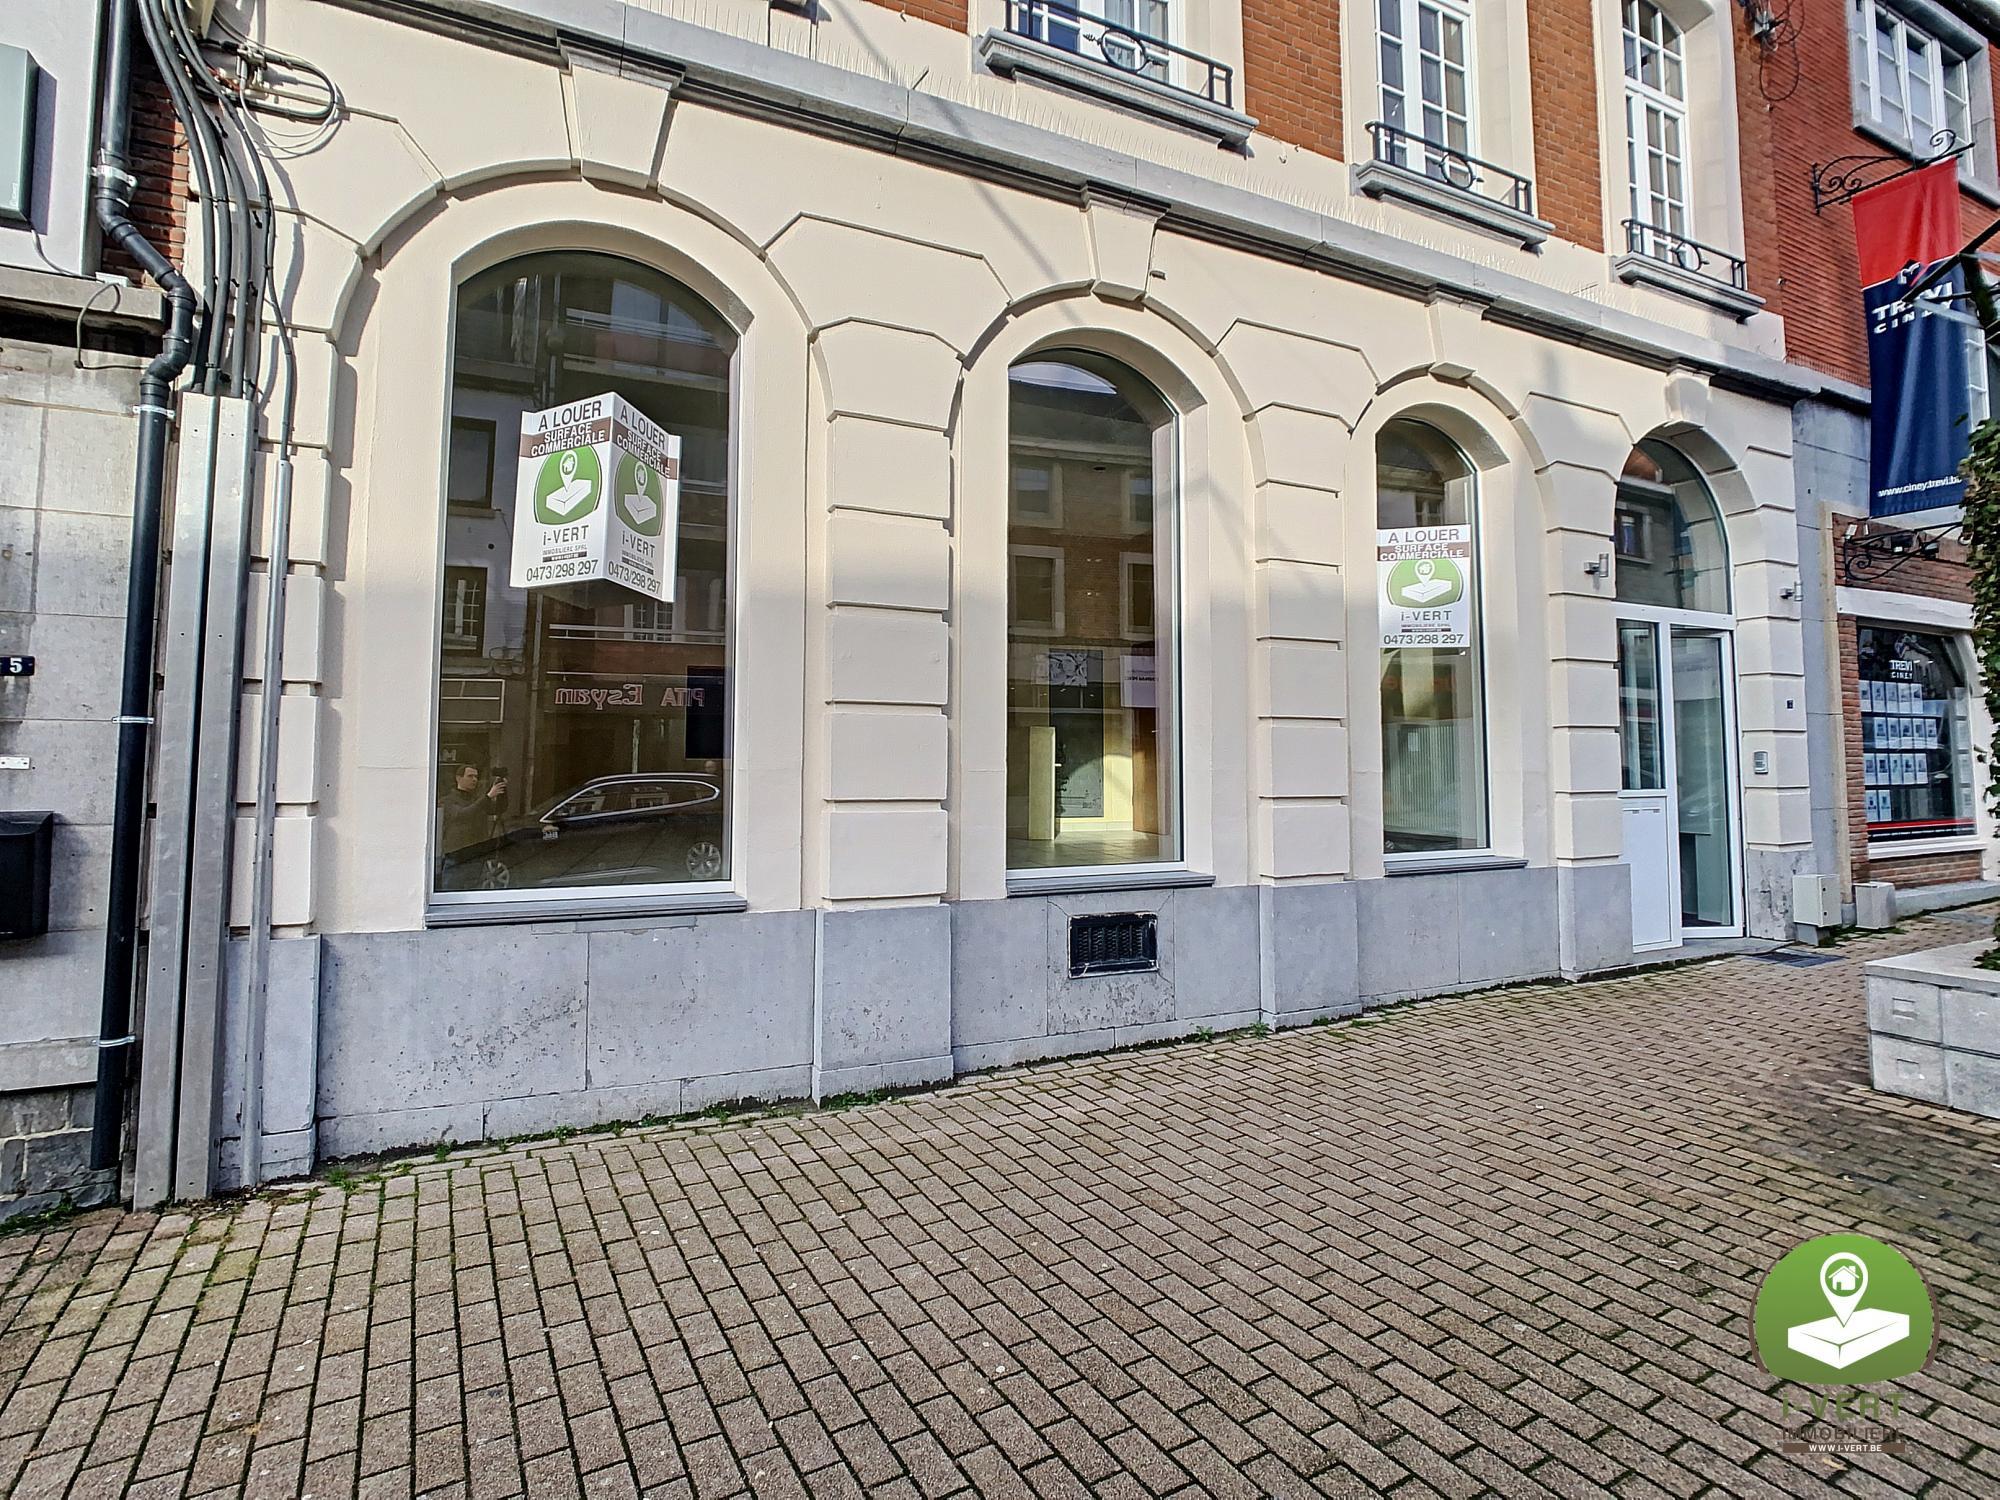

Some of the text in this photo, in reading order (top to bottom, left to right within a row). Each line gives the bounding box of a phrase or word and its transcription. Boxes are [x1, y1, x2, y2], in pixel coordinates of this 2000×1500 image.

[1872, 281, 1953, 320] TRVI
[538, 400, 602, 432] A LOUER
[620, 404, 666, 450] A LOUER
[531, 429, 606, 456] COMMERCIALE
[544, 422, 592, 443] SURFACE
[616, 434, 671, 478] COMMERCIALE
[627, 430, 661, 462] SURFACE
[543, 525, 589, 546] i-VERT
[622, 530, 655, 558] i-VERT
[1388, 528, 1460, 544] A LOUER
[1380, 549, 1464, 561] COMMERCIALE
[1394, 543, 1449, 553] SURFACE
[526, 559, 599, 582] 0473/298 297
[608, 560, 646, 588] 0473/298
[647, 577, 661, 594] 297
[1401, 610, 1452, 621] i-VERT
[1383, 634, 1464, 645] 0473/298 297
[9, 657, 23, 673] 5
